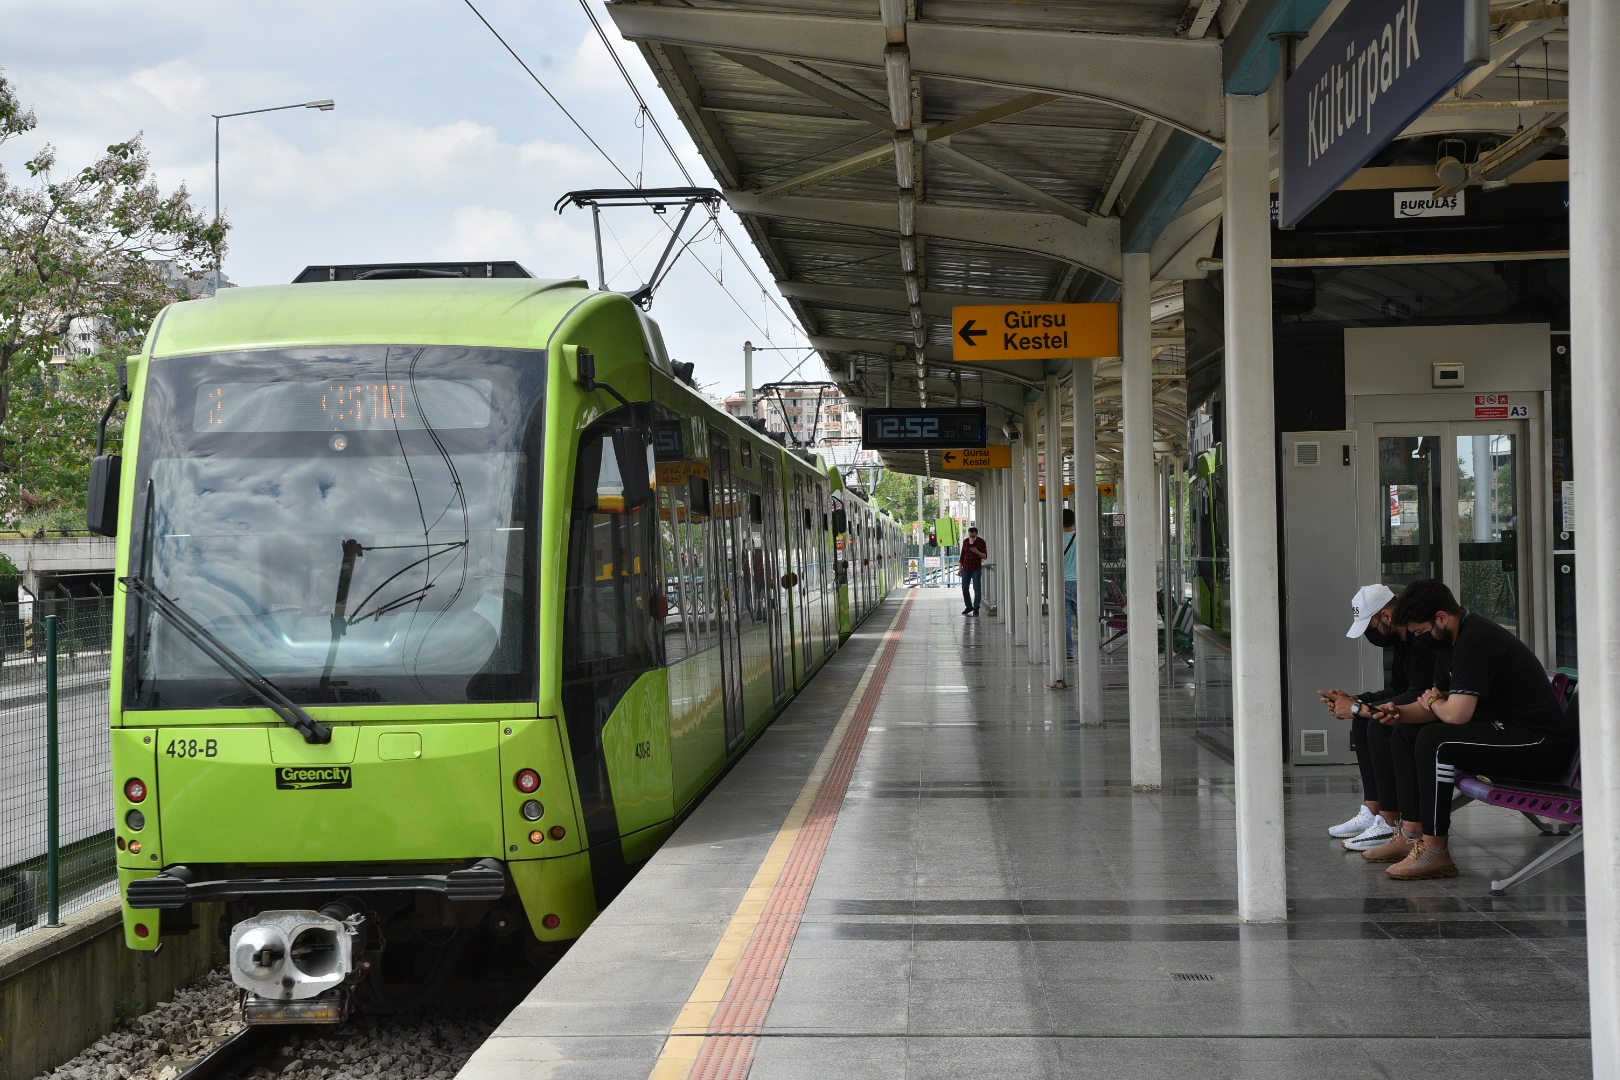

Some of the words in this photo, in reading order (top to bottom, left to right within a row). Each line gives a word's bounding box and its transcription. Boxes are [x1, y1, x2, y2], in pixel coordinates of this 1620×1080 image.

[1308, 0, 1421, 167] Kültürpark
[1400, 198, 1457, 211] BURULAŞ
[1004, 310, 1066, 329] Gürsu
[1003, 331, 1068, 350] Kestel
[1511, 406, 1527, 416] A3
[875, 418, 939, 438] 12:52
[963, 449, 990, 457] Gürsu
[963, 457, 990, 466] Kestel
[166, 739, 218, 758] 438-B
[281, 767, 350, 784] Greencity
